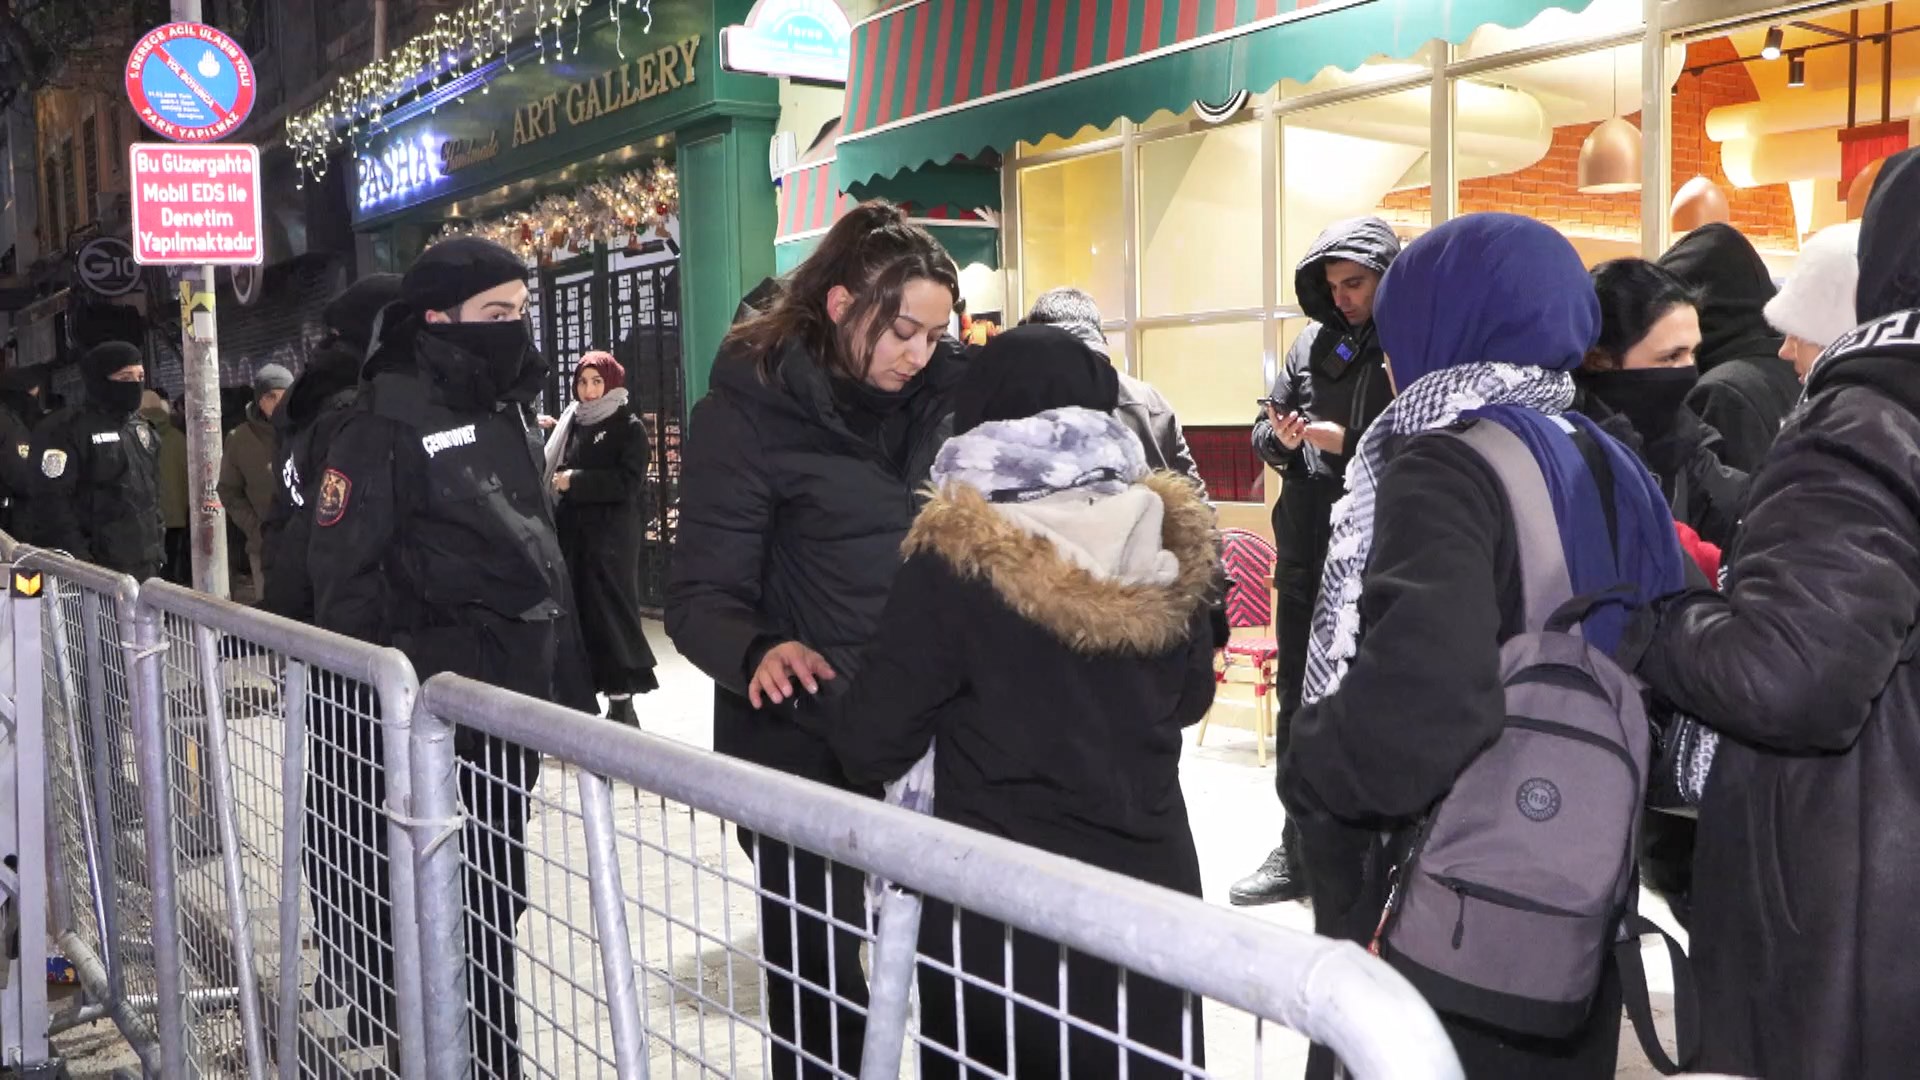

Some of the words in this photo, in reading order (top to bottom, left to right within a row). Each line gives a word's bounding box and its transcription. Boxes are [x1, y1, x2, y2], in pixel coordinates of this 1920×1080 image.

[236, 58, 251, 87] YOLU
[512, 93, 561, 148] ART
[566, 34, 701, 127] GALLERY
[142, 107, 175, 134] PARK
[179, 112, 239, 138] YAPILMAZ
[137, 152, 159, 173] Bu
[162, 152, 252, 178] Güzergahta
[143, 183, 189, 203] Mobil
[192, 183, 225, 203] EDS
[228, 183, 248, 203] ile
[161, 206, 234, 227] Denetim
[140, 231, 255, 257] Yapılmaktadır
